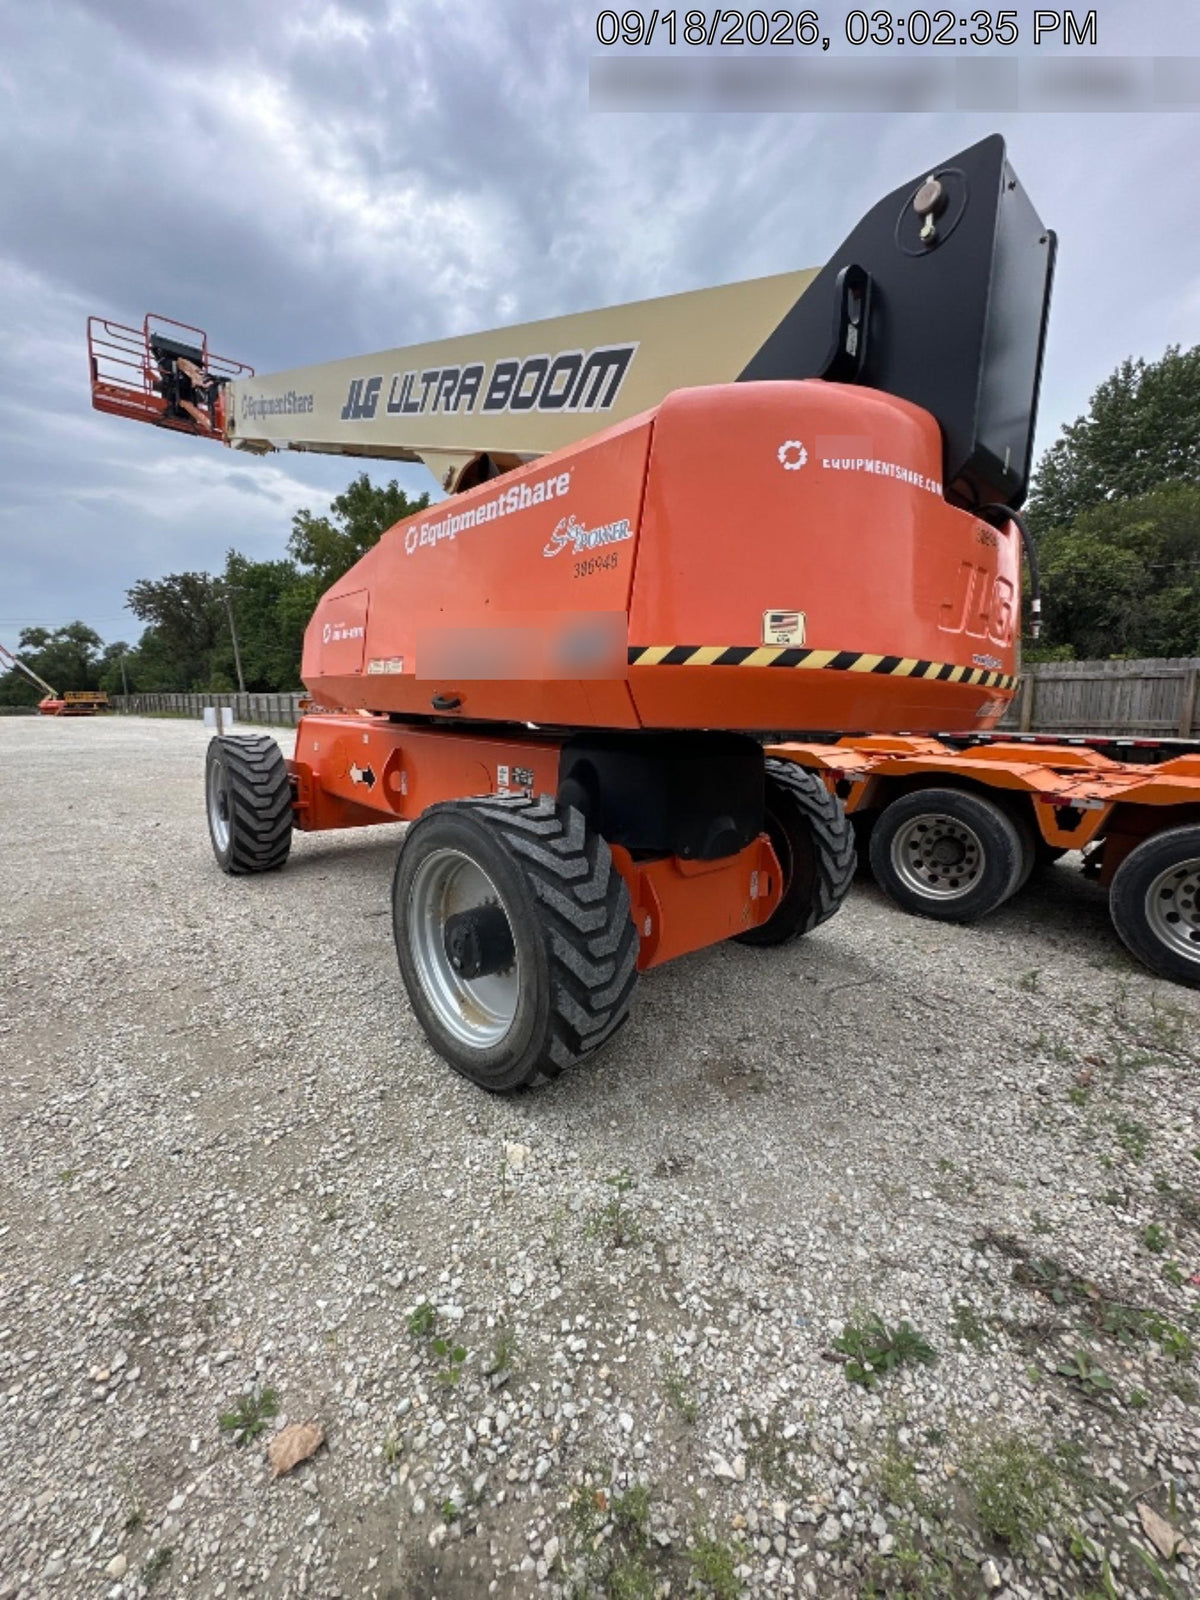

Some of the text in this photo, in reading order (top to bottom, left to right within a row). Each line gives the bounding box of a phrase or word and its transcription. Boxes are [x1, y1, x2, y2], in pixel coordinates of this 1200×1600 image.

[340, 341, 640, 422] JLG ULTRA BOOM
[419, 471, 570, 546] EquipmentShare
